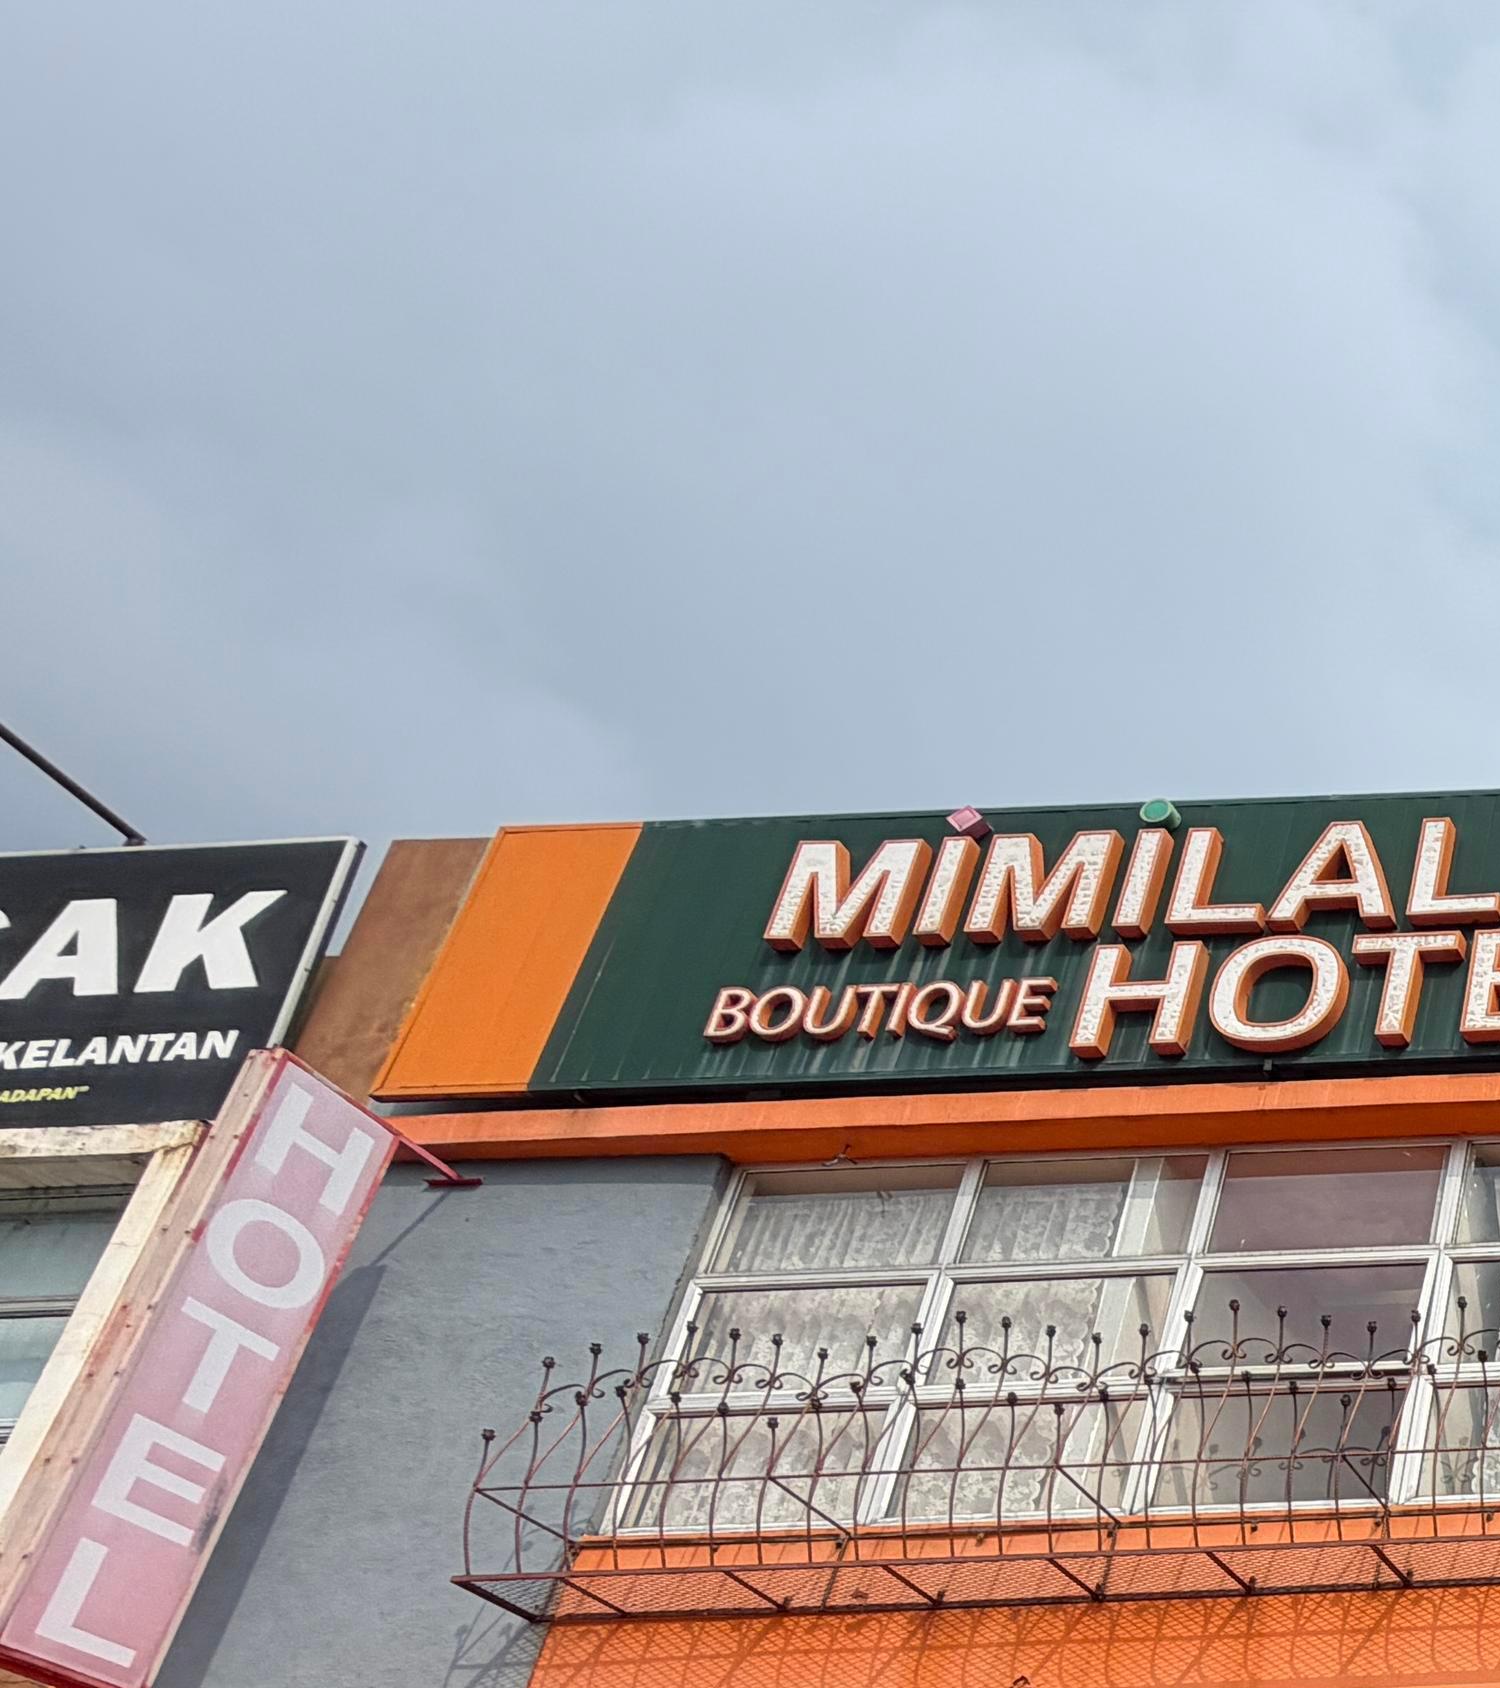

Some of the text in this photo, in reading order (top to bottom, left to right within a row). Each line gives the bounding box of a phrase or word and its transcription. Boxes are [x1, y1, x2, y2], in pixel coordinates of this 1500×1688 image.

[0, 889, 288, 1000] AK
[0, 1029, 240, 1070] KELANTAN
[703, 974, 1060, 1047] BOUTIQUE
[35, 1081, 375, 1668] HOTEL
